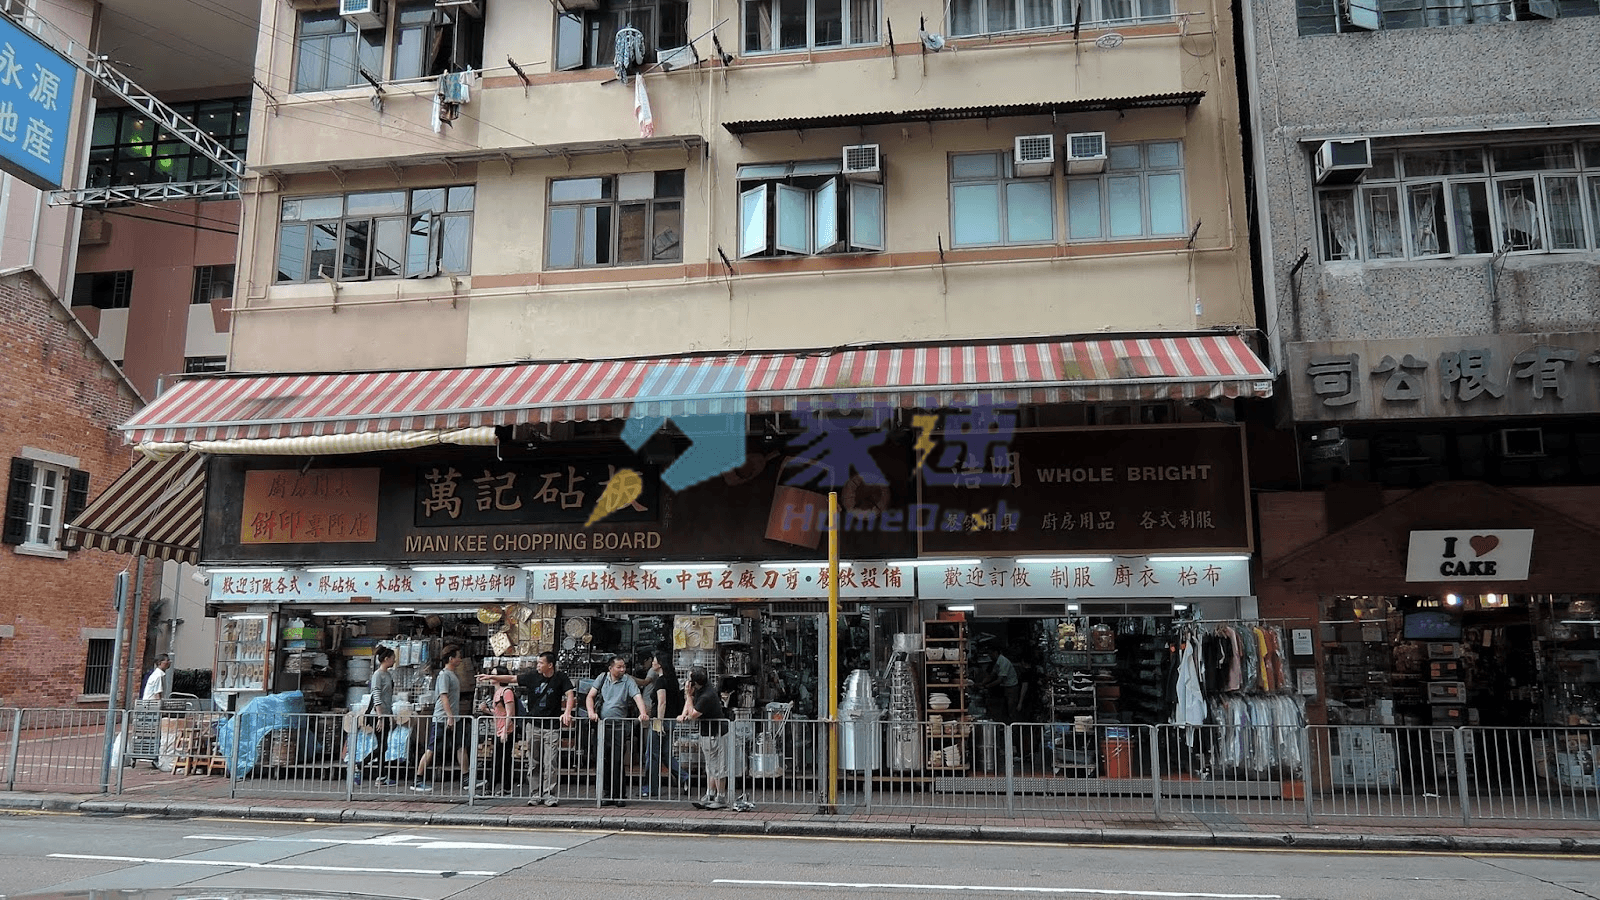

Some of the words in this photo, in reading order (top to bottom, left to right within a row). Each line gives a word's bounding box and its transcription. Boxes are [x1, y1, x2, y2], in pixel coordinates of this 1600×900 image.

[1036, 466, 1114, 483] WHOLE
[1126, 464, 1212, 481] BRIGHT
[1040, 510, 1115, 531] 廚房用品
[1139, 510, 1216, 530] 各式制服
[404, 535, 449, 552] MAN
[454, 535, 488, 552] KEE
[493, 533, 587, 551] CHOPPING
[592, 531, 661, 550] BOARD
[1442, 536, 1458, 558] I
[942, 566, 1031, 589] 歡迎訂做
[1049, 566, 1095, 588] 制服
[1112, 565, 1160, 588] 廚衣
[1439, 560, 1497, 577] CAKE
